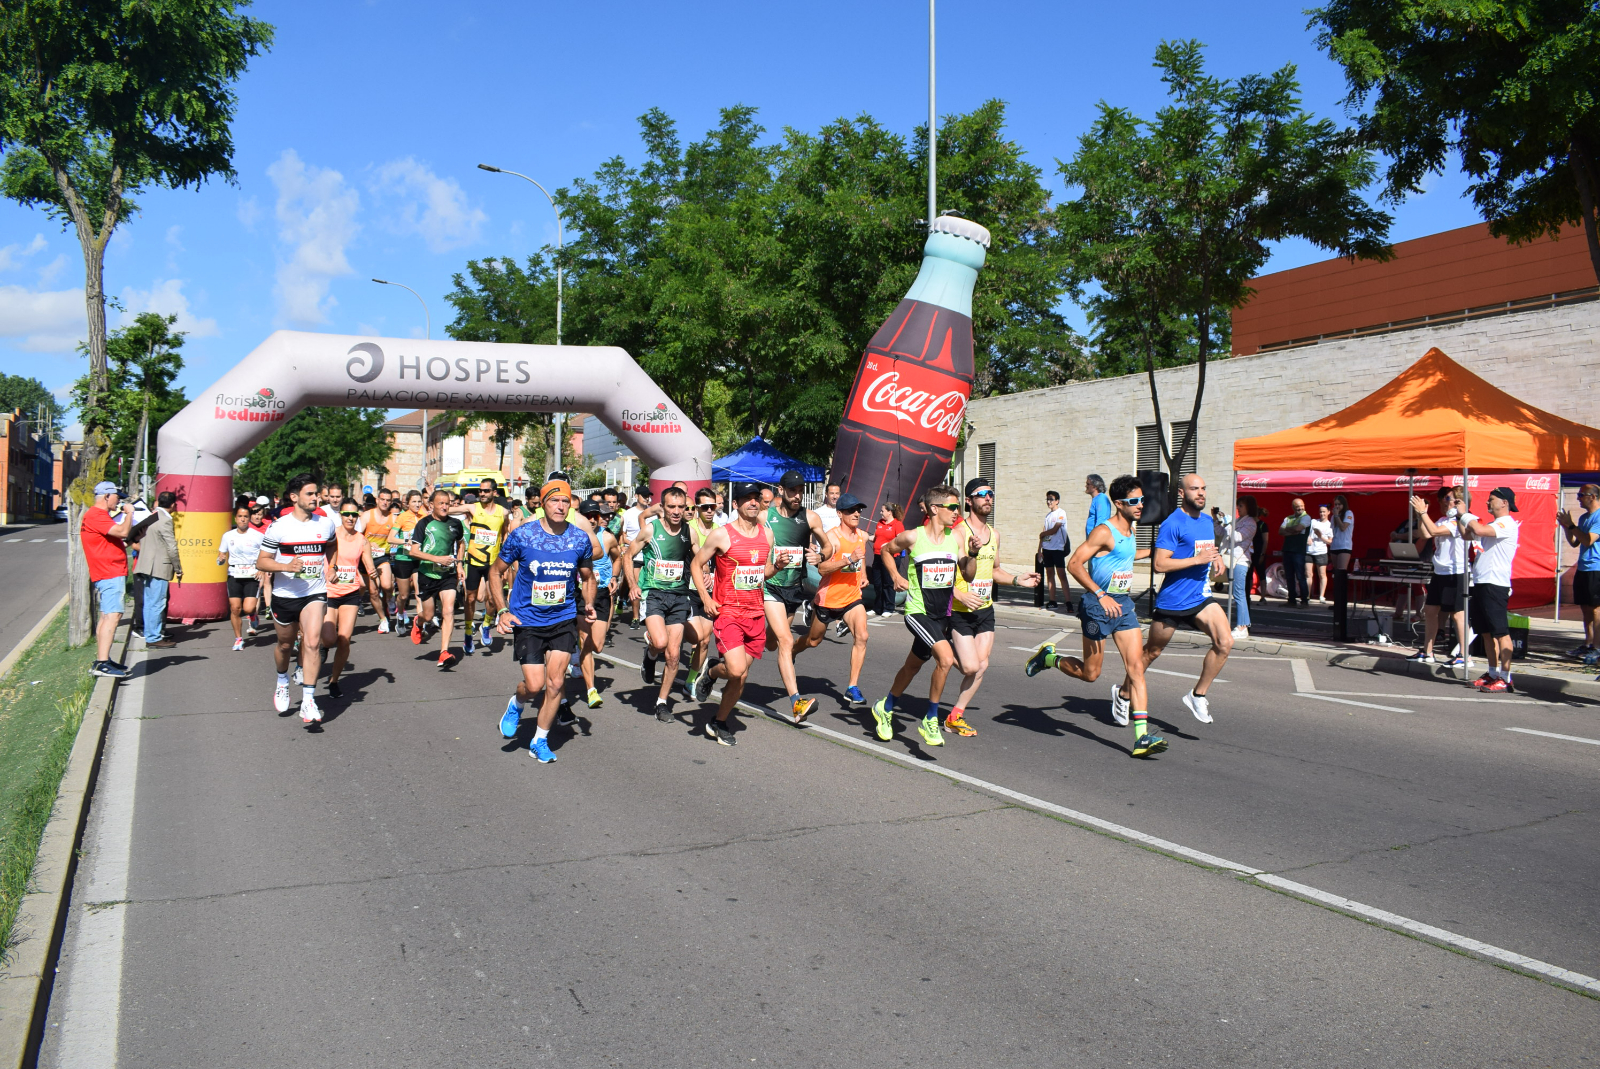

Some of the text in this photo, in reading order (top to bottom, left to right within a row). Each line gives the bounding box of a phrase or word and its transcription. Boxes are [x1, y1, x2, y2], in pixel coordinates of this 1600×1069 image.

[399, 354, 531, 384] HOSPES
[215, 394, 286, 410] floristería
[347, 388, 575, 407] PALACIO DE SAN ESTEBAN
[622, 409, 678, 421] floristería
[177, 538, 213, 546] OSPES
[293, 544, 322, 554] CANALLA
[540, 560, 574, 570] apaches
[744, 576, 758, 584] 184
[934, 573, 945, 582] 47
[544, 591, 555, 599] 98
